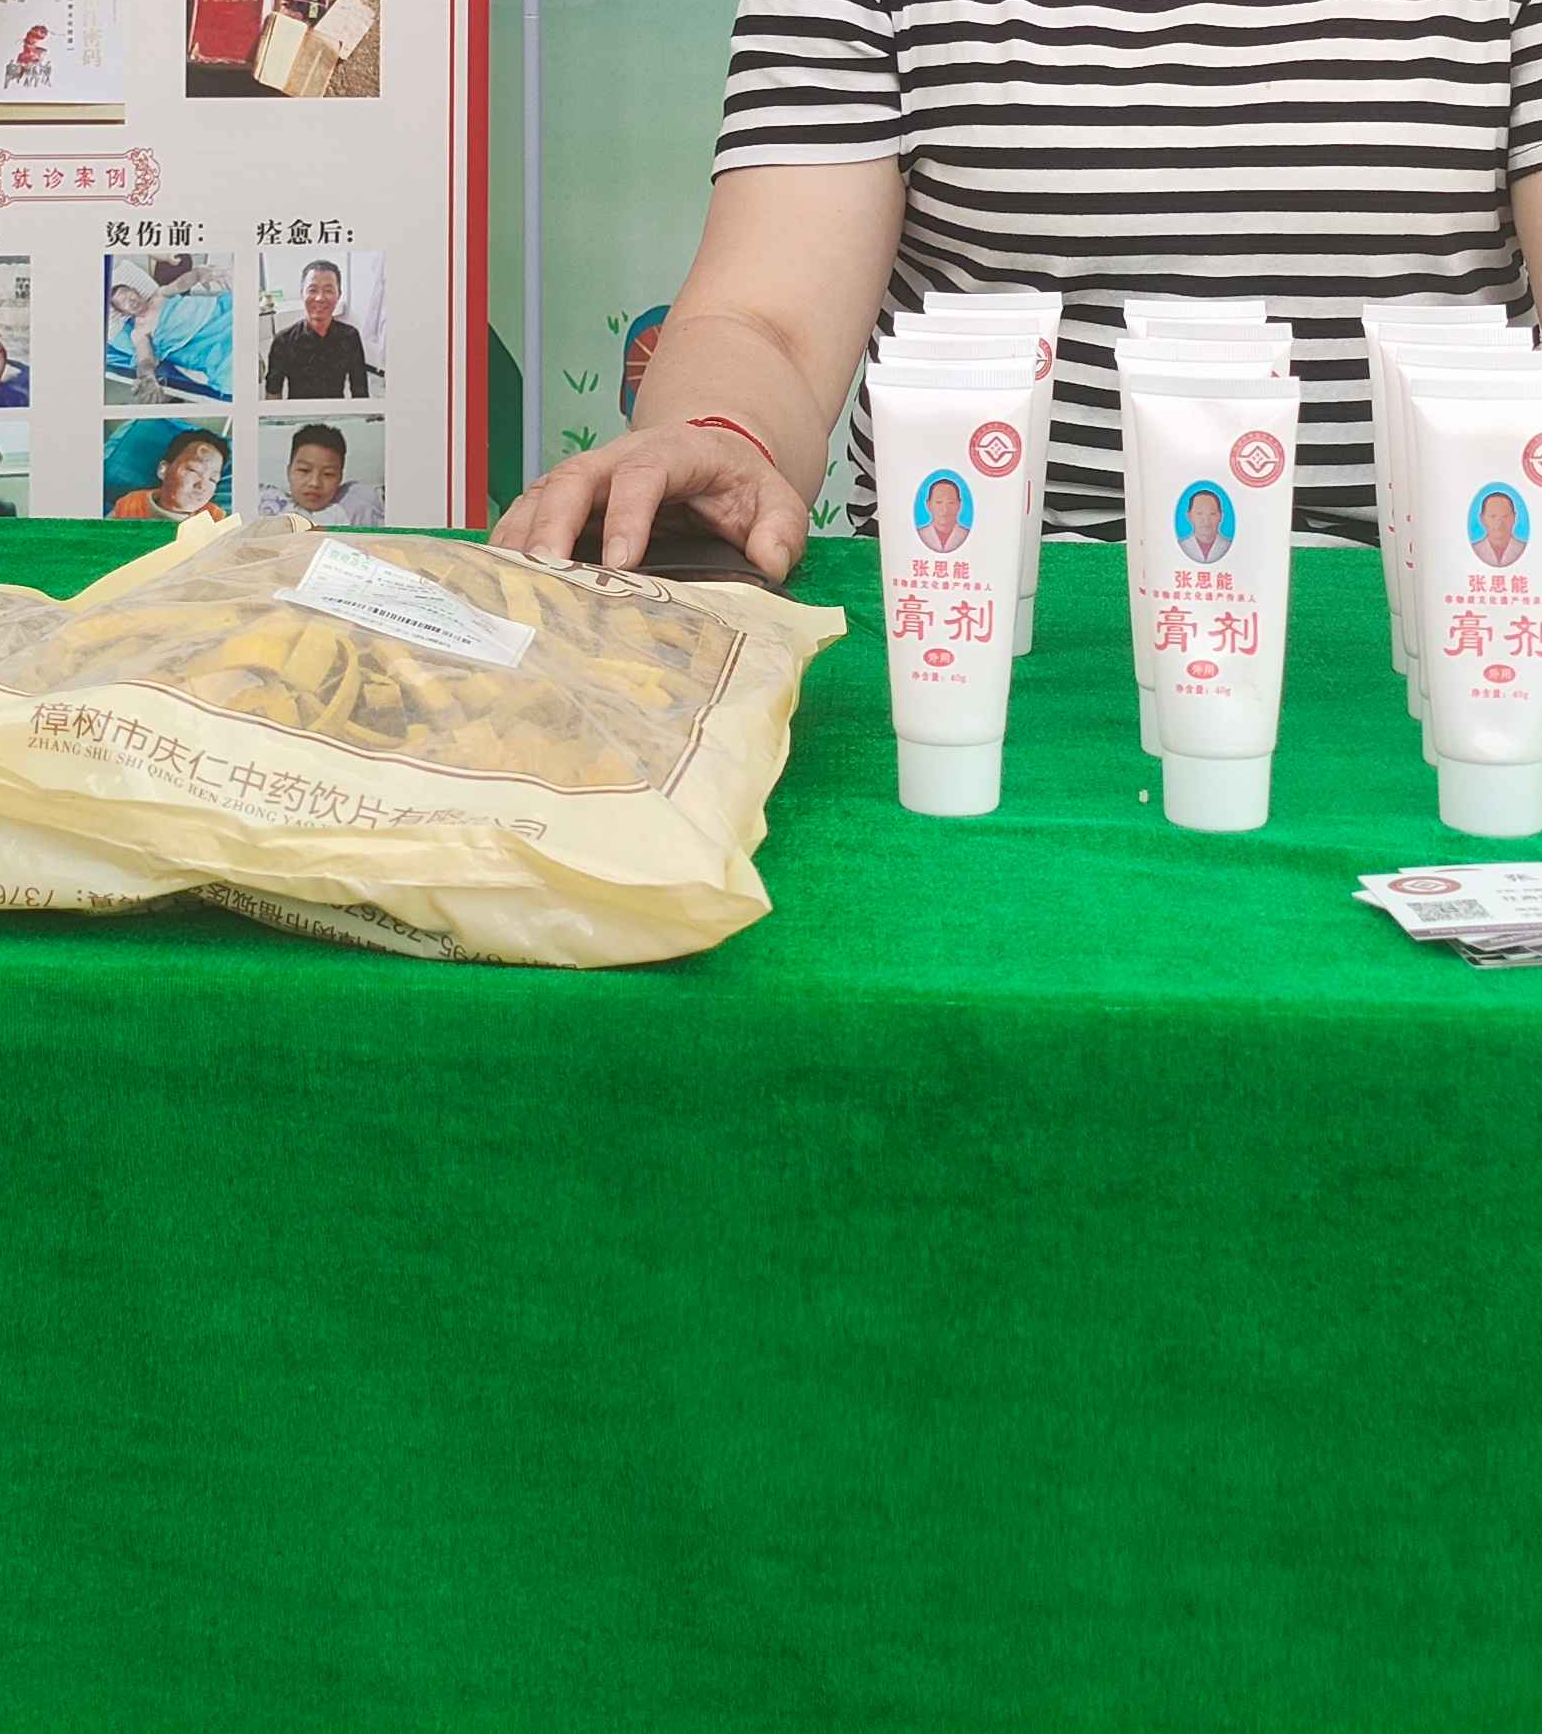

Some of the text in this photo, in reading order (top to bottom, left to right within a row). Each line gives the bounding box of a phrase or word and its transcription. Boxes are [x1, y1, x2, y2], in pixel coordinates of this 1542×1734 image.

[10, 165, 130, 191] 就诊案例
[103, 217, 207, 251] 烫伤前：
[255, 217, 357, 250] 痊愈后：
[911, 558, 970, 581] 张思能
[1174, 570, 1234, 591] 张思能
[1467, 573, 1529, 595] 张思能
[891, 593, 995, 643] 膏剂
[1153, 605, 1259, 656] 膏剂
[27, 736, 82, 759] ZHANG
[81, 743, 114, 763] SHU
[115, 750, 144, 769] SHI
[146, 762, 185, 790] QING
[186, 782, 219, 806] REN
[219, 793, 280, 822] ZHONG
